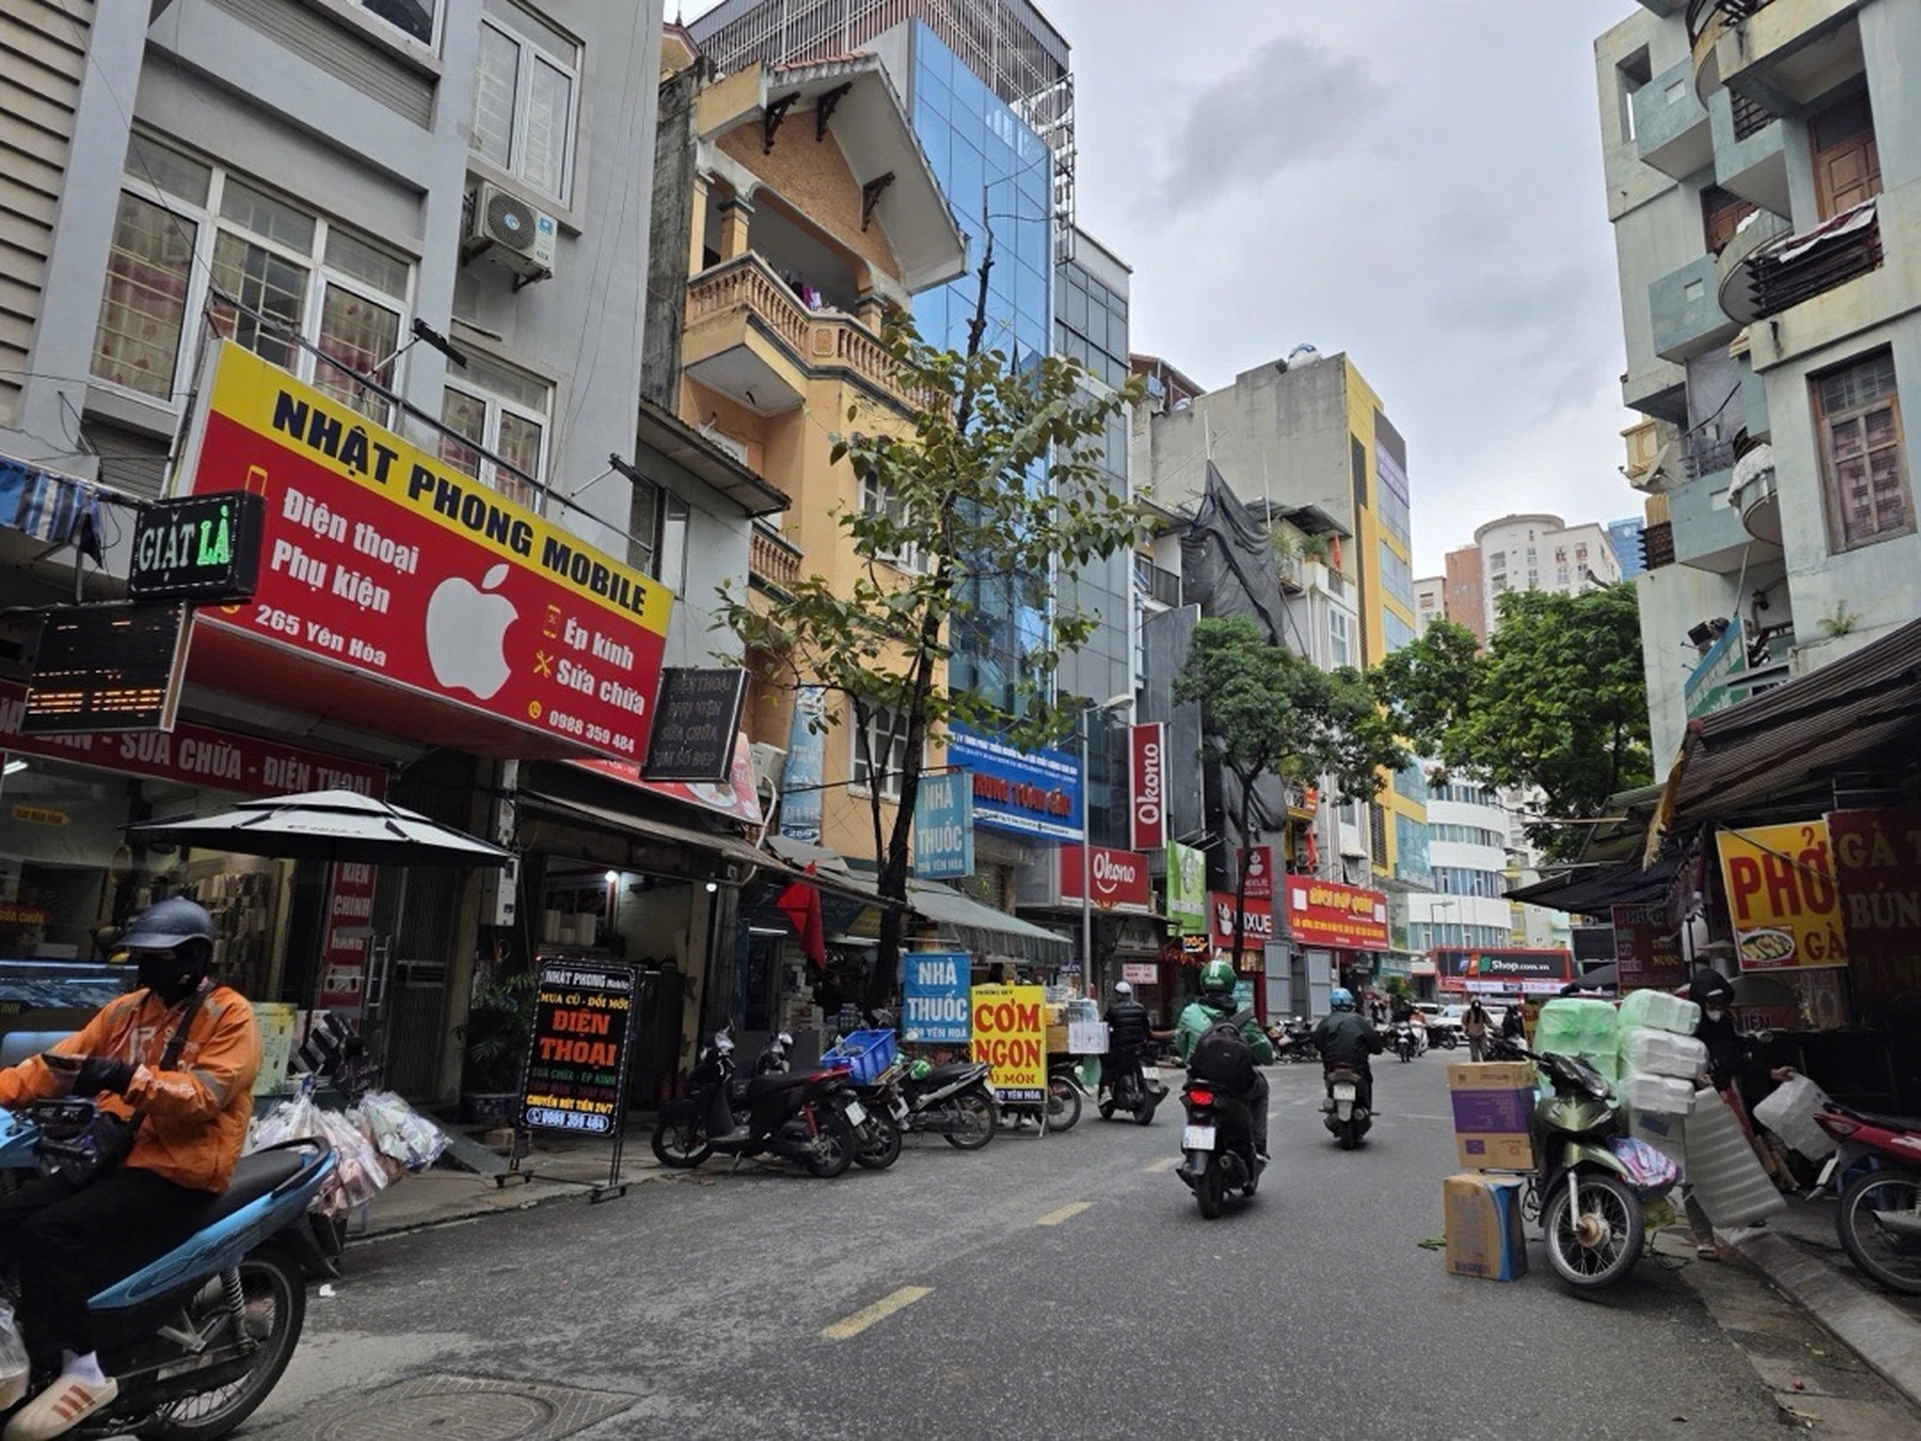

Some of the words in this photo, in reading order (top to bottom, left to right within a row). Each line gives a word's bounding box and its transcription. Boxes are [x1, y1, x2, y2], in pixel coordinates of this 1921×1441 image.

[272, 389, 399, 484] NHẬT
[408, 464, 534, 557] PHONG
[541, 536, 647, 616] MOBILE
[138, 510, 196, 582] GIẶT
[282, 487, 348, 543] Điện
[353, 522, 420, 575] thoại
[271, 538, 327, 592] Phụ
[332, 564, 391, 614] kiện
[254, 604, 300, 636] 265
[306, 620, 344, 652] Yên
[348, 638, 387, 667] Hòa
[563, 616, 589, 651] Ép
[592, 631, 635, 671] kính
[556, 658, 595, 696] Sửa
[599, 681, 645, 716] chữa
[549, 710, 583, 735] 0988
[586, 724, 611, 745] 359
[611, 733, 635, 753] 484
[178, 740, 242, 780] CHỮA
[262, 755, 312, 794] ĐIỆN
[1136, 743, 1160, 825] Okono
[924, 777, 954, 812] NHÀ
[917, 816, 963, 855] THUỐC
[1838, 821, 1899, 868] GÀ
[1093, 851, 1135, 883] Okono
[1728, 826, 1835, 921] PHỞ
[1804, 921, 1848, 961] GÀ
[919, 957, 958, 985] NHÀ
[540, 993, 562, 1005] MUA
[907, 990, 968, 1022] THUỐC
[975, 998, 1041, 1034] CƠM
[552, 1008, 611, 1037] ĐIỆN
[927, 1026, 946, 1038] YÊN
[539, 1036, 619, 1070] THOẠI
[975, 1039, 1041, 1068] NGON
